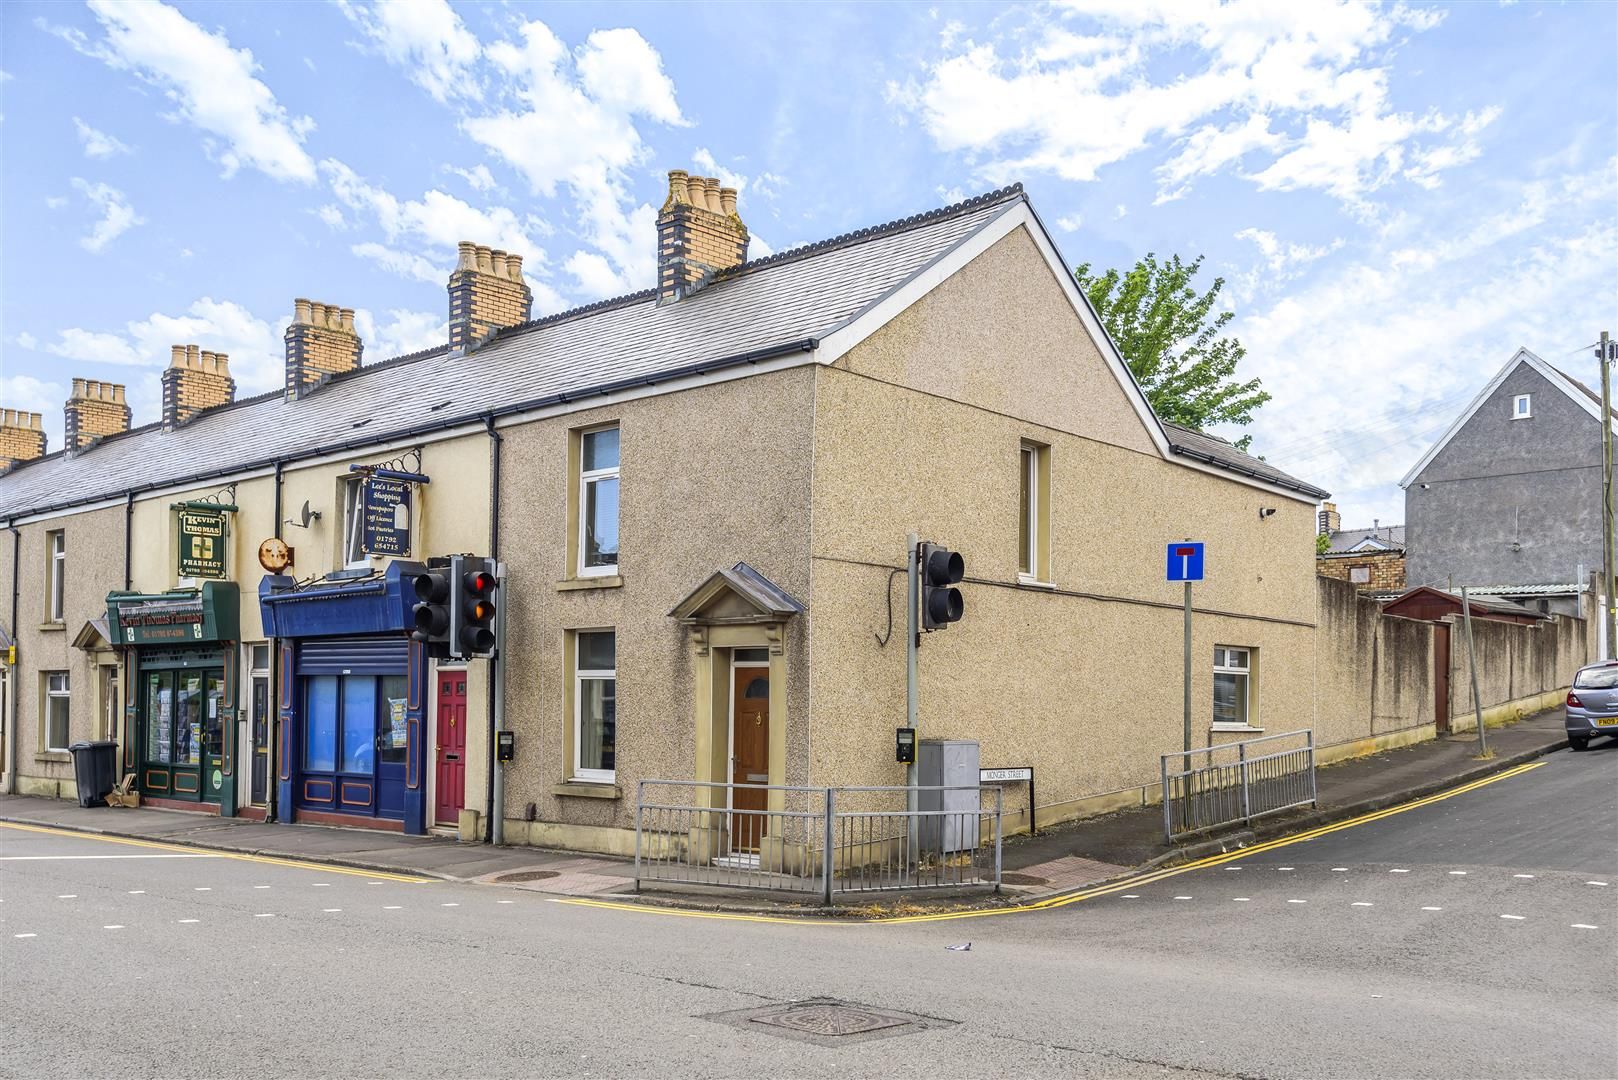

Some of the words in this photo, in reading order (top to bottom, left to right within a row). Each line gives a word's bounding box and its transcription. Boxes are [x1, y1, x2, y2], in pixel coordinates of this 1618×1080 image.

[373, 491, 401, 504] Shopping
[187, 516, 215, 525] KEVIN
[186, 525, 219, 534] THOMAS
[376, 535, 397, 543] 01792
[374, 543, 399, 551] 654715
[183, 559, 221, 567] PHARMACY
[986, 771, 1006, 779] MONGER
[1008, 770, 1024, 778] STREET
